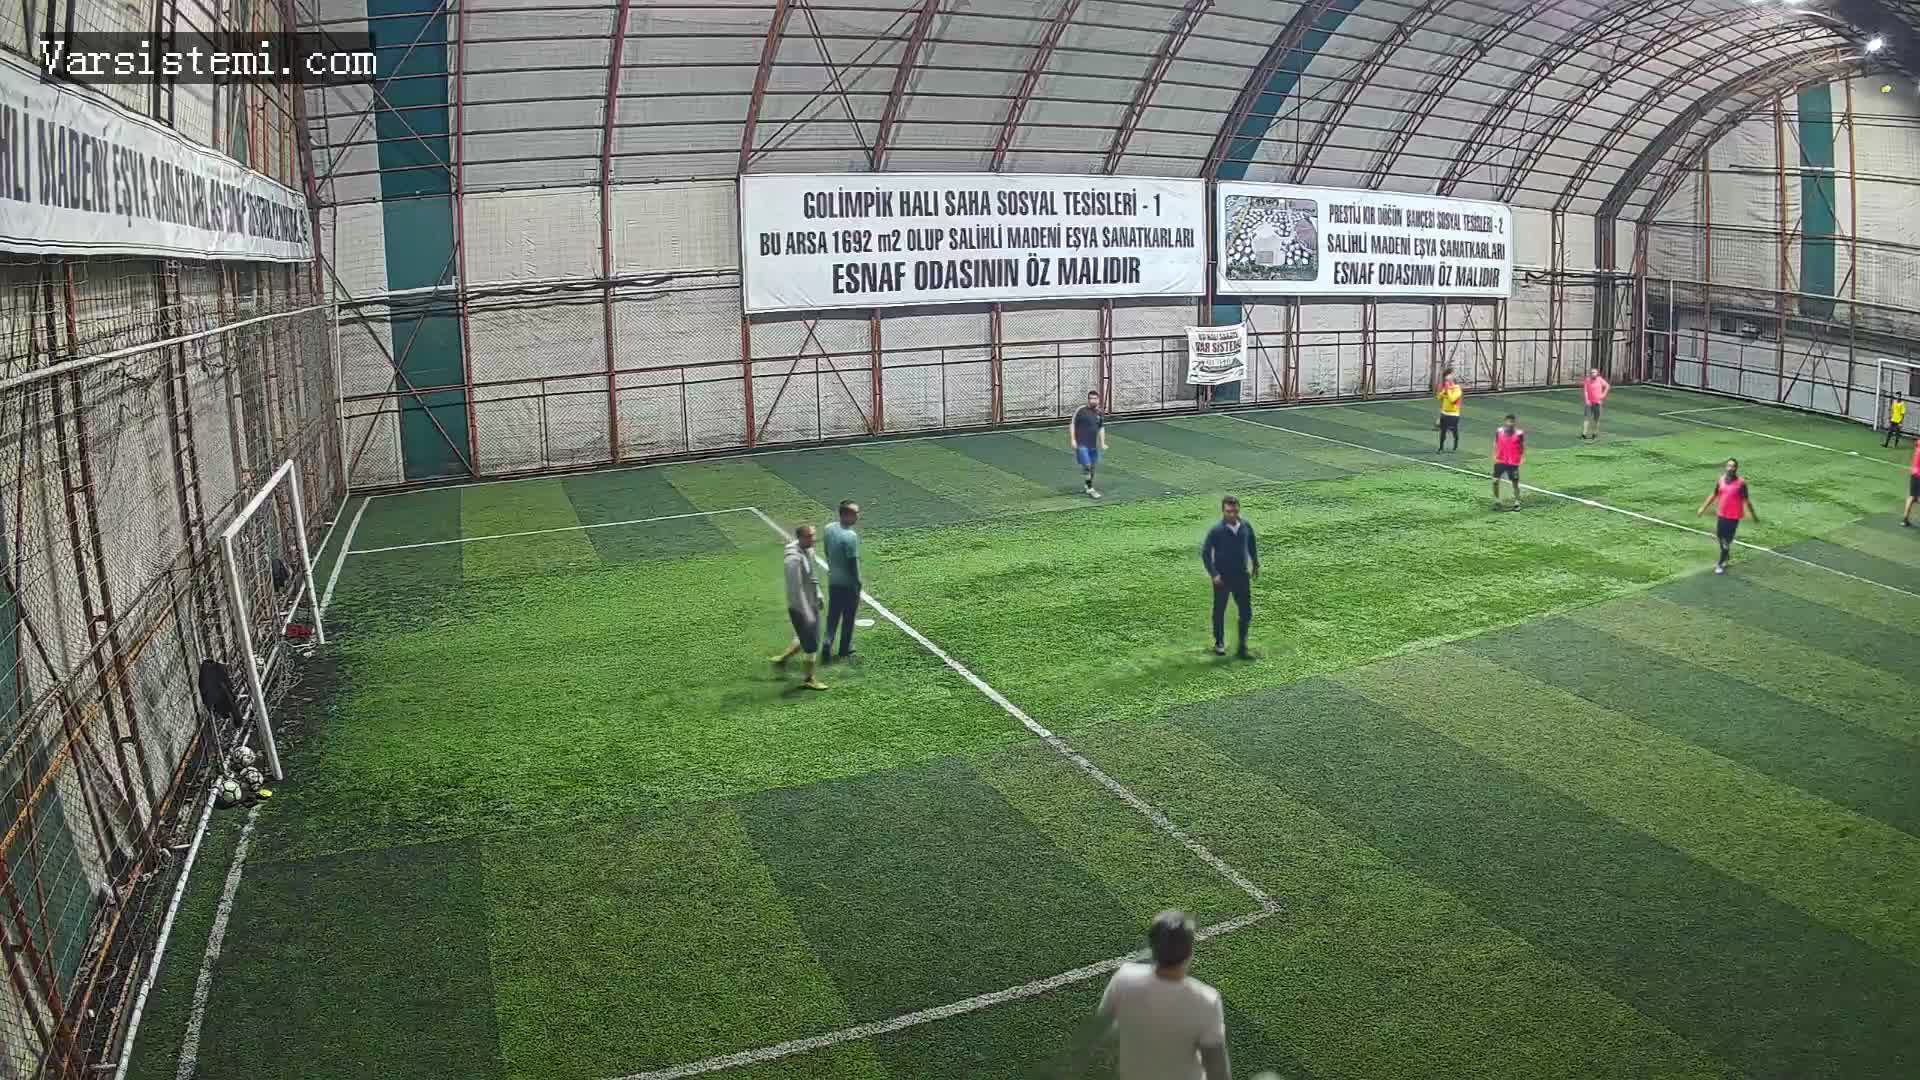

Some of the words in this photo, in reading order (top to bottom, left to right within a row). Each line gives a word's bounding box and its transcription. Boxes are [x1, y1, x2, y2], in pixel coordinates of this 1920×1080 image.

[803, 187, 894, 219] GOLİMPİK
[899, 191, 939, 217] HALI
[945, 190, 991, 216] SAHA
[997, 190, 1058, 216] SOSYAL
[1063, 188, 1137, 216] TESİSLERİ
[1153, 193, 1161, 216] 1
[1329, 201, 1361, 225] PRESTİJ
[1377, 204, 1403, 227] DÜĞÜN
[1406, 208, 1435, 231] BAHÇESİ
[1437, 211, 1461, 231] SOSYAL
[760, 232, 781, 256] BU
[785, 231, 828, 255] ARSA
[832, 230, 873, 253] 1692
[878, 229, 902, 252] m2
[907, 229, 944, 251] OLUP
[949, 224, 1002, 250] SALİHLİ
[1007, 223, 1061, 249] MADENİ
[1066, 226, 1098, 251] EŞYA
[1102, 227, 1195, 249] SANATKARLARI
[1327, 232, 1367, 254] SALİHLİ
[1371, 234, 1411, 255] MADENİ
[1414, 238, 1437, 259] EŞYA
[1439, 239, 1505, 260] SANATKARLARI
[833, 262, 905, 294] ESNAF
[914, 258, 1019, 290] ODASININ
[1026, 252, 1050, 287] ÖZ
[1057, 256, 1141, 286] MALIDIR
[1334, 261, 1375, 285] ESNAF
[1378, 263, 1435, 286] ODASININ
[1438, 262, 1452, 286] ÖZ
[1455, 265, 1500, 287] MALIDIR
